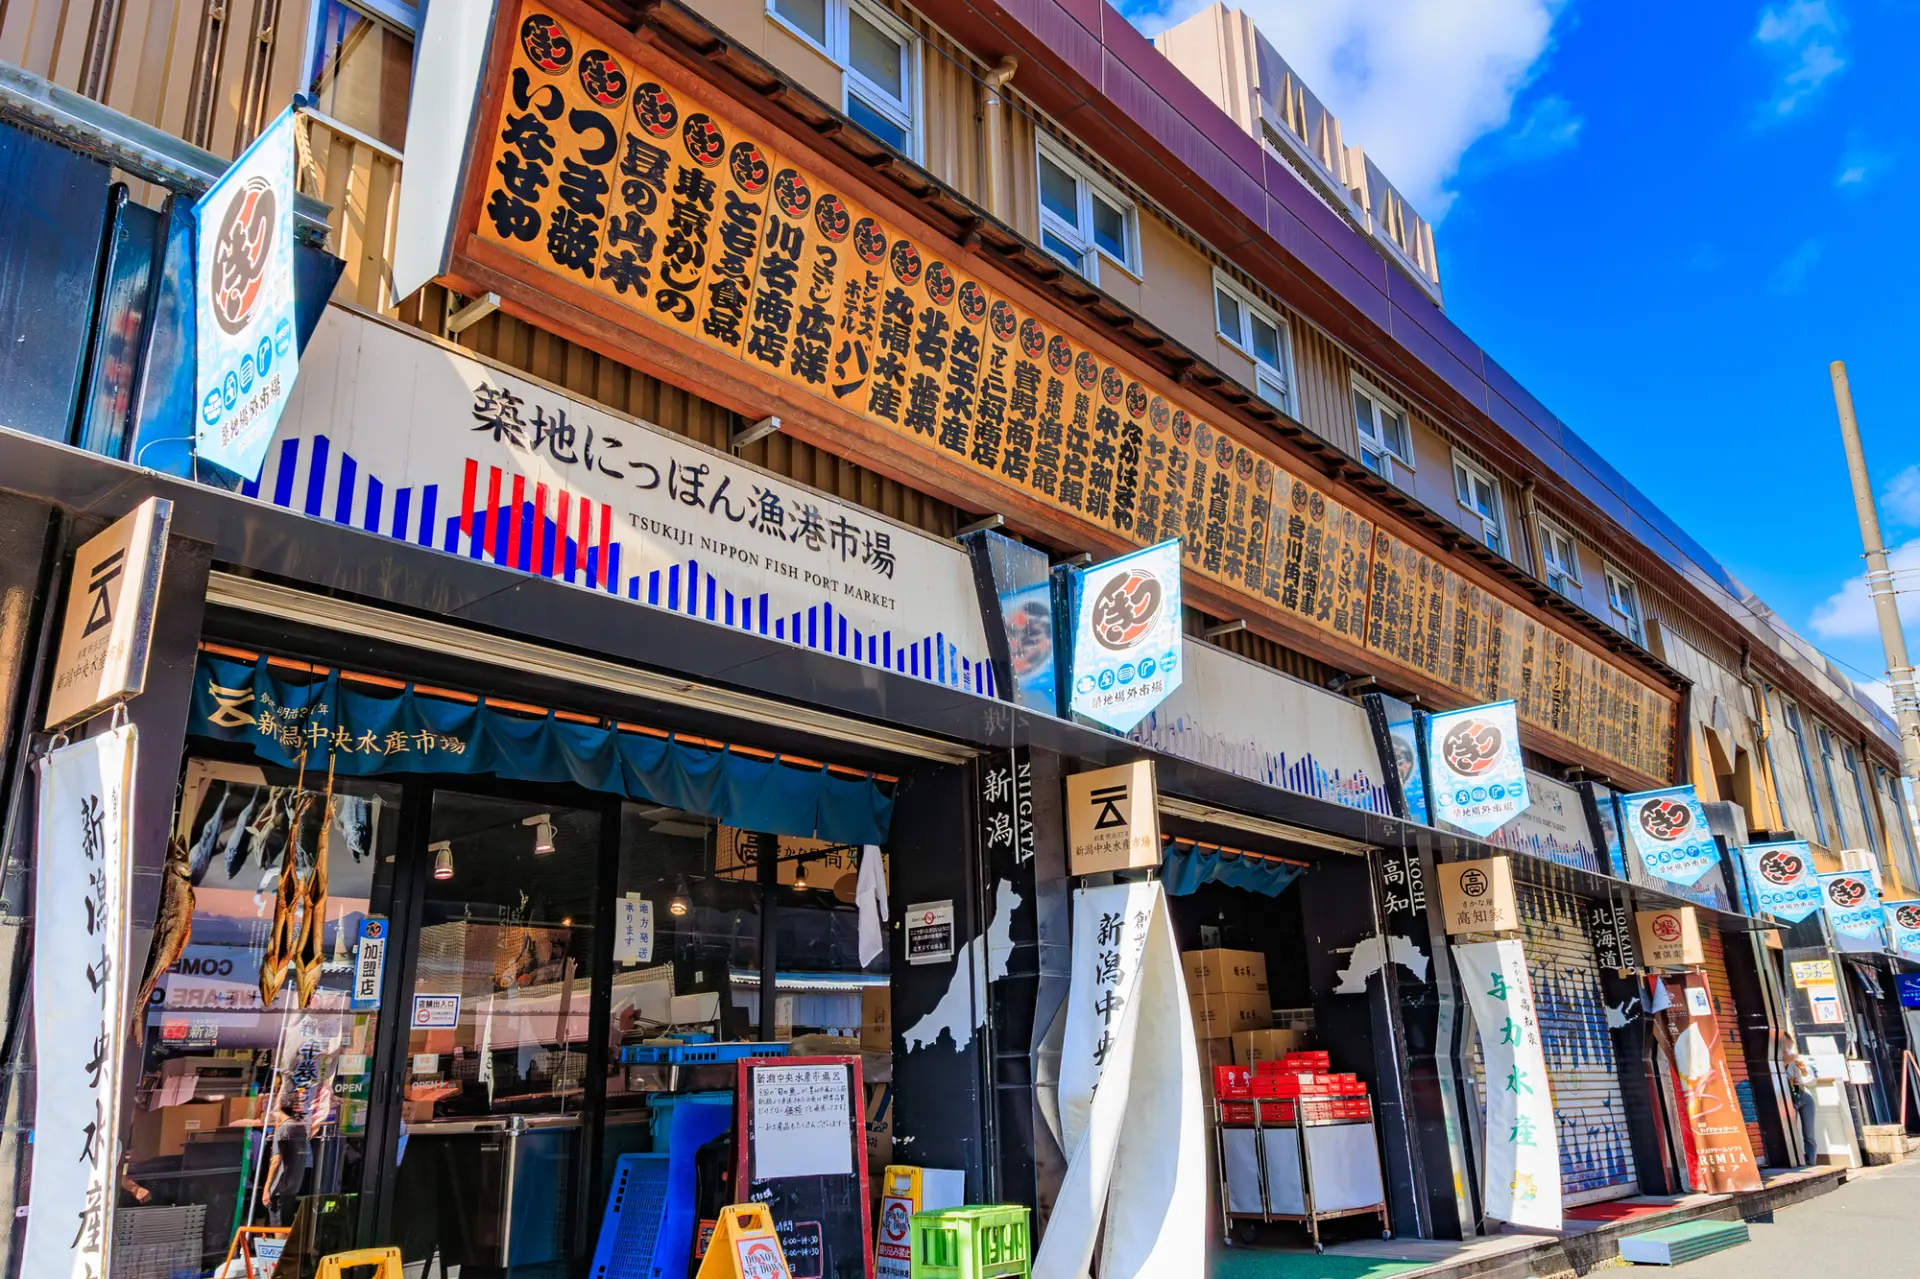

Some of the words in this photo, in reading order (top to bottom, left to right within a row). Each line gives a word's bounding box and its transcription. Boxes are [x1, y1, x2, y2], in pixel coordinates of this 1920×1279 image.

[488, 68, 563, 240] いなせや
[600, 134, 669, 295] 豆の山本
[656, 167, 714, 321] 東京かじの
[748, 216, 803, 365] 川名商店
[791, 246, 836, 383] つきじ広洋
[840, 279, 861, 332] ホテル
[856, 270, 880, 340] ビジネス
[832, 340, 868, 398] バン
[869, 288, 913, 421] 丸福水産
[904, 308, 948, 435] 若葉
[939, 326, 978, 454] 丸玉水産
[1002, 360, 1040, 481] 菅野商店
[1059, 393, 1089, 510] 築地江戸銀
[471, 382, 897, 580] 築地にっぽん漁港市場
[1135, 434, 1165, 544] ヤマト運輸
[1203, 472, 1229, 572] 北島商店
[629, 513, 694, 546] TSUKIJI
[700, 536, 760, 567] NIPPON
[765, 557, 799, 579] FISH
[804, 571, 839, 593] PORT
[844, 584, 897, 611] MARKET
[1223, 483, 1246, 579] 築地正本
[256, 710, 467, 756] 新潟中央水産市場
[983, 768, 1014, 848] 新潟
[1018, 762, 1034, 862] NIIGATA
[624, 901, 635, 948] 承ります
[638, 902, 650, 960] 地方発送
[1383, 859, 1409, 914] 高知
[1409, 857, 1426, 910] KOCHI
[1456, 908, 1504, 925] 高知家
[360, 943, 378, 995] 加盟店
[1592, 908, 1621, 970] 北海道
[1615, 908, 1636, 975] HOKKAIDO
[1090, 912, 1127, 1104] 新潟中央
[335, 1083, 362, 1093] OPEN
[1487, 972, 1538, 1147] 与力水産
[745, 1255, 757, 1265] DO
[759, 1251, 776, 1263] NOT
[745, 1266, 758, 1277] SIT
[759, 1261, 785, 1275] DOWN
